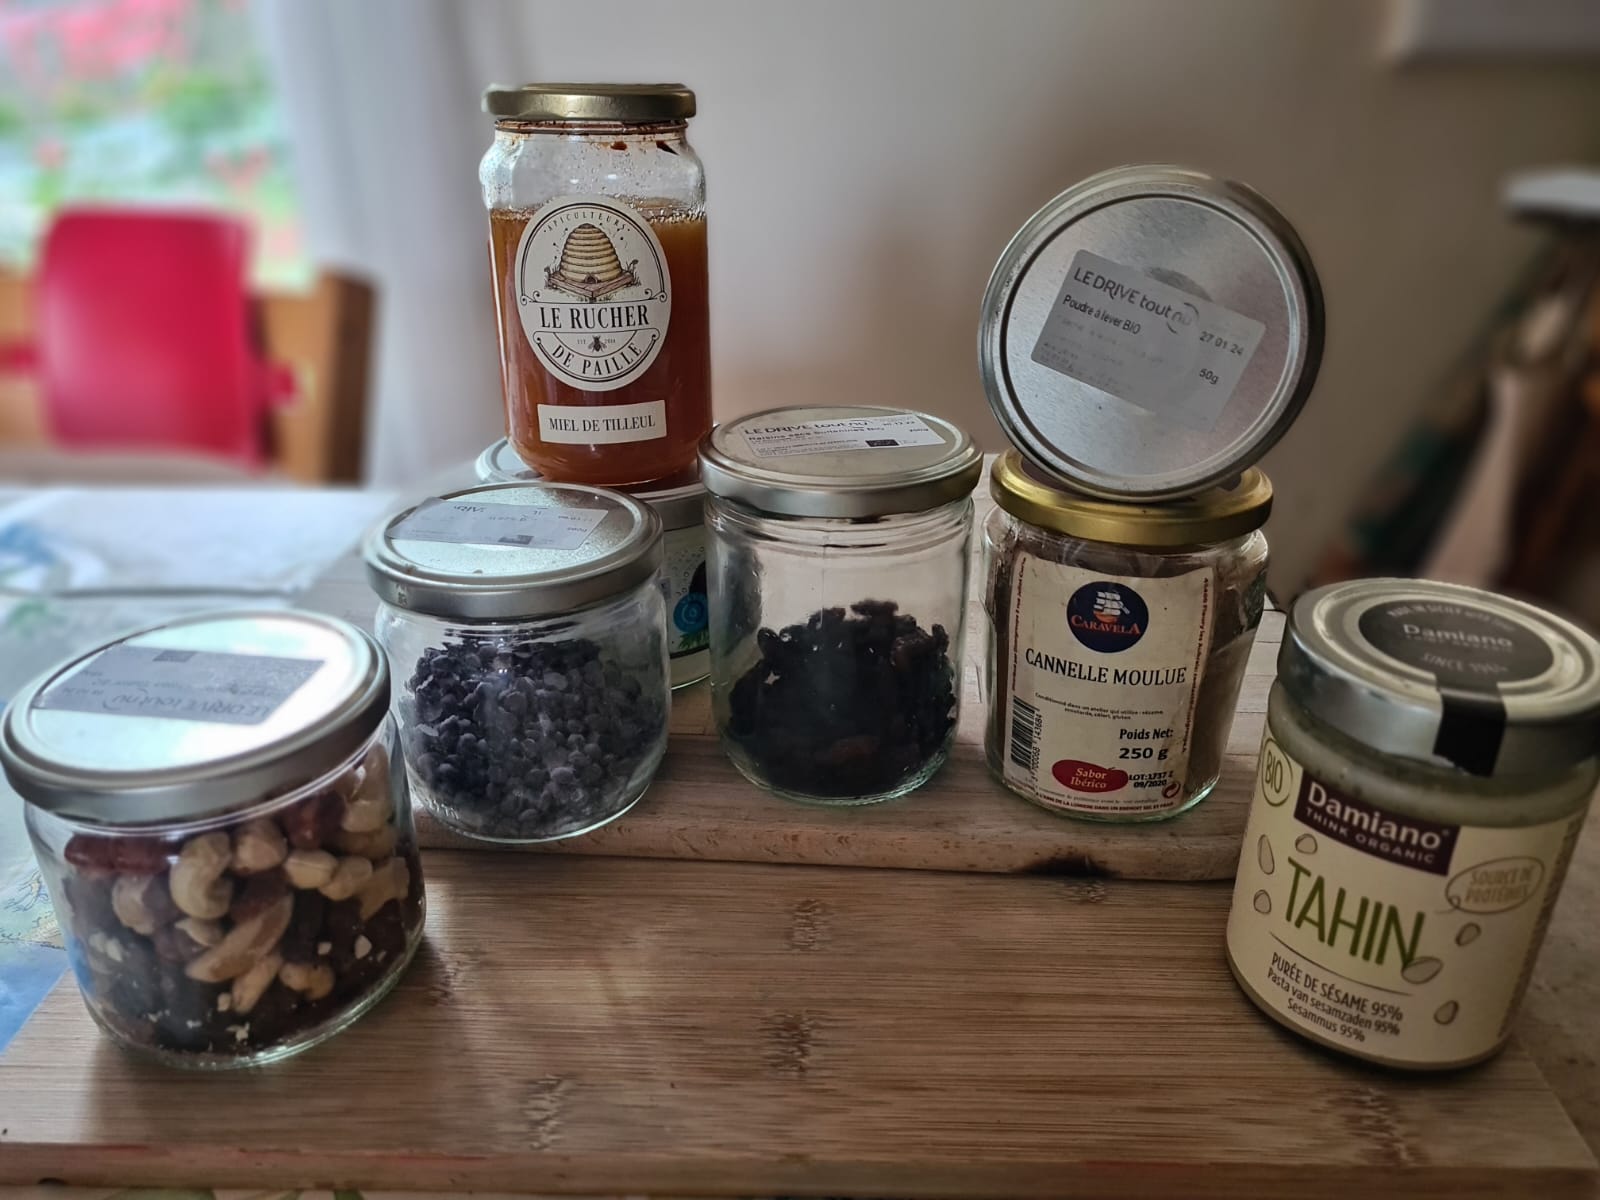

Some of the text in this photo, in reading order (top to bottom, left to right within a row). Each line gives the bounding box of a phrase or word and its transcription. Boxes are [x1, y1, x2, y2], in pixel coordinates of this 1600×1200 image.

[1074, 267, 1094, 287] LE
[1092, 273, 1140, 304] DRIVE
[1139, 298, 1173, 319] tout
[540, 304, 650, 329] LE RUCHER
[1063, 294, 1141, 335] Poudre à lever BIO
[1199, 331, 1245, 356] 27 01 24
[552, 342, 643, 376] DE PAILLE
[1199, 367, 1220, 385] 50g
[549, 414, 656, 432] MIEL DE TILLEUL
[764, 424, 812, 434] DRIVE
[1071, 614, 1142, 636] CARAVELA
[1403, 624, 1513, 648] Damiano
[1025, 648, 1188, 686] CANNELLE MOULUE
[1421, 653, 1463, 671] SINCE
[186, 700, 246, 714] DRIVE
[1119, 727, 1174, 741] Poids Net:
[1119, 747, 1169, 761] 250 g
[1070, 776, 1107, 789] Ibérico
[1074, 767, 1107, 780] Sabor
[1264, 750, 1284, 794] BIO
[1308, 782, 1442, 851] Damiano
[1306, 808, 1436, 865] THINK ORGANIC
[1284, 857, 1425, 971] TAHIN
[1271, 953, 1404, 1021] PURÉE DE SÉSAME 95%
[1267, 969, 1400, 1036] Pasta van sesamzaden 95%
[1287, 997, 1366, 1043] Sesammus 95%
